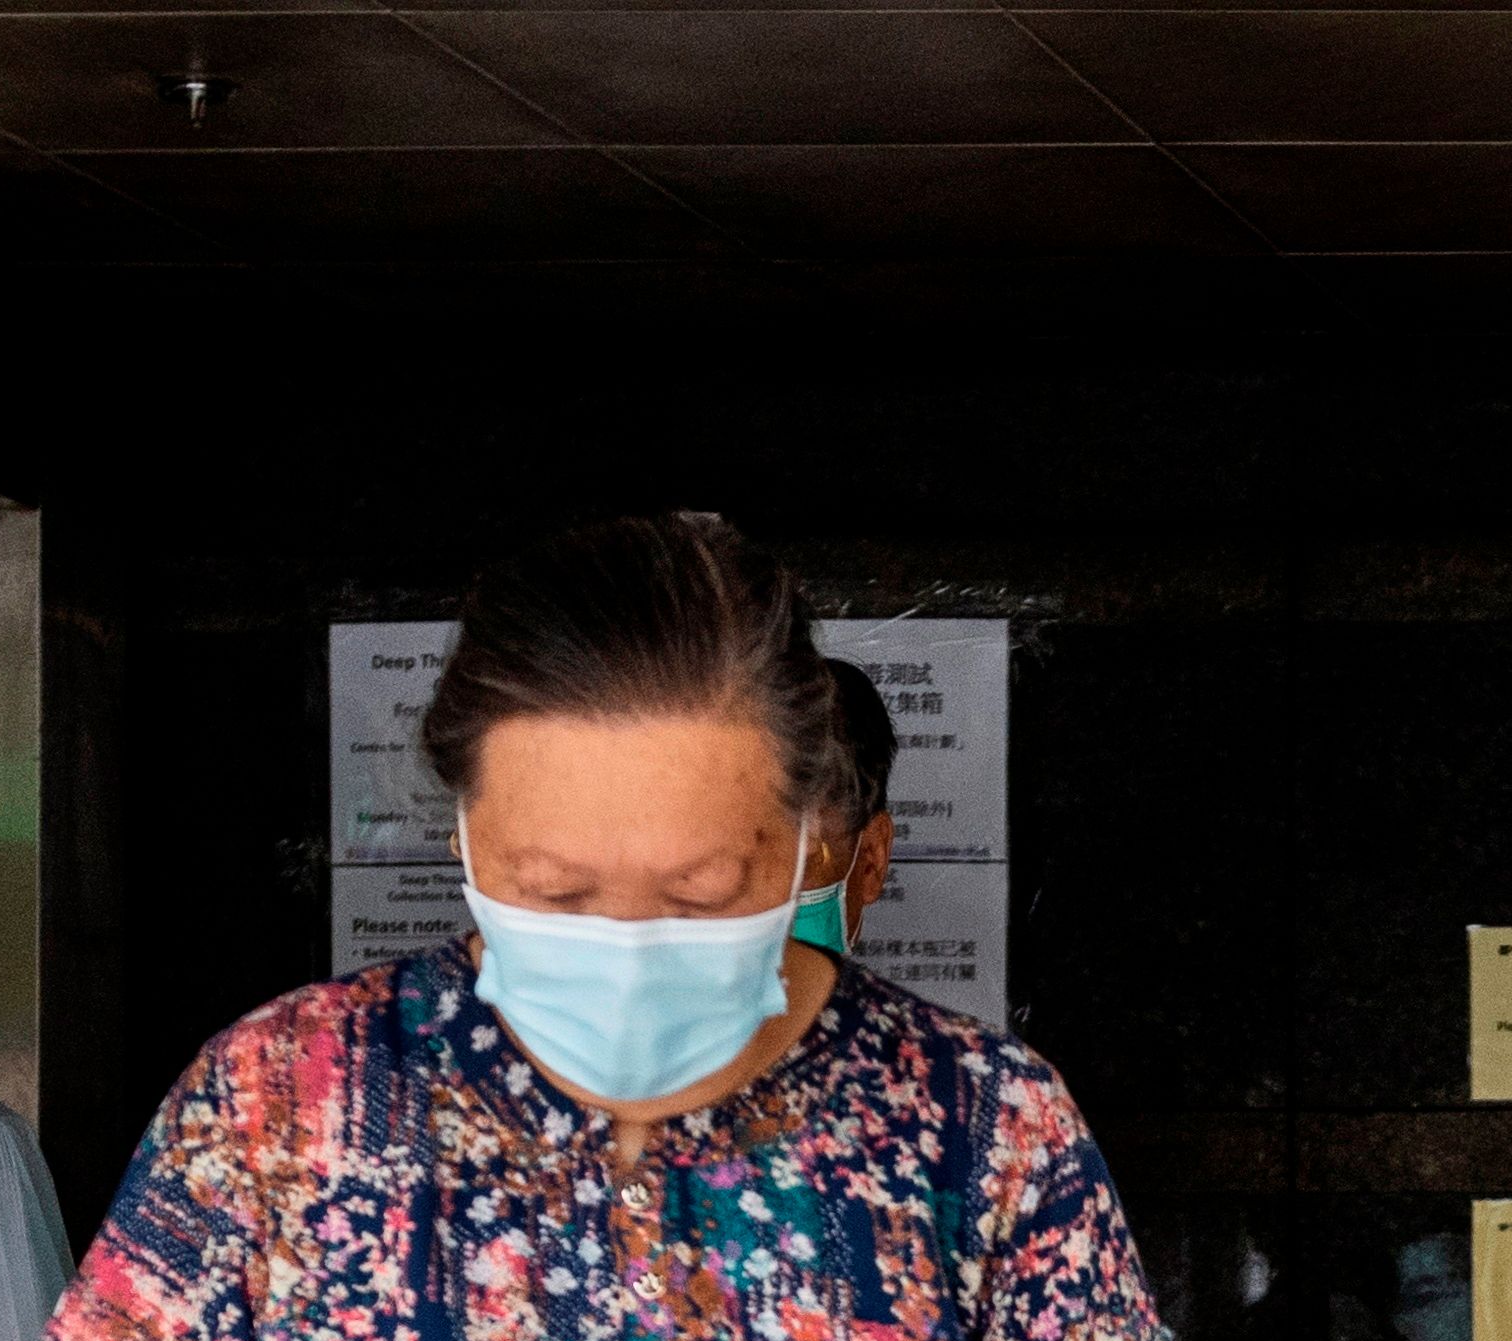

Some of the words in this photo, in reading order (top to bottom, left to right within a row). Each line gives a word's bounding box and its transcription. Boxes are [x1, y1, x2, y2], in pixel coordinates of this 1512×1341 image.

[371, 653, 416, 672] Deep
[352, 917, 409, 933] Please
[412, 918, 459, 934] note:
